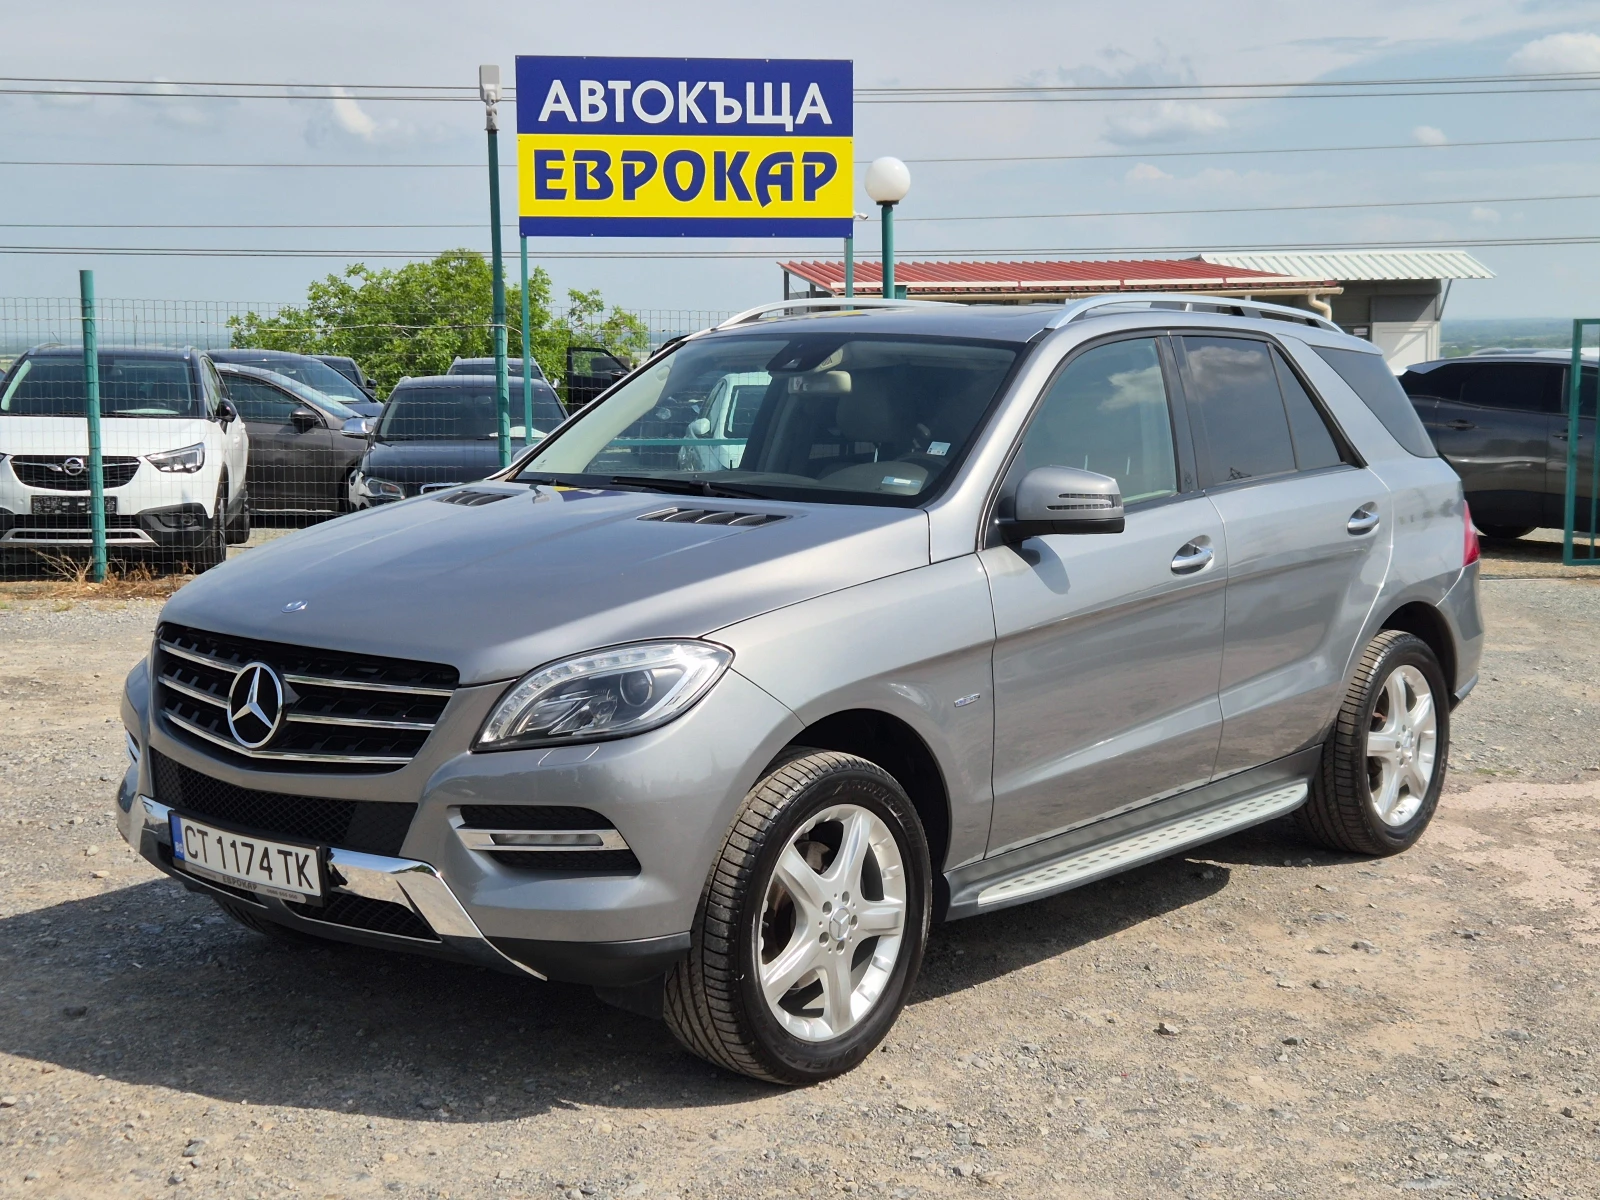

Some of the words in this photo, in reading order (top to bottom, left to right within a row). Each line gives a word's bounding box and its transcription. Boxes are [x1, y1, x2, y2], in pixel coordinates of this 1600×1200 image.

[537, 79, 833, 132] АВТОКЪЩА
[533, 149, 838, 208] ЕВРОКАР
[184, 825, 208, 864] CT
[216, 836, 273, 881] 1174
[277, 849, 314, 890] TK
